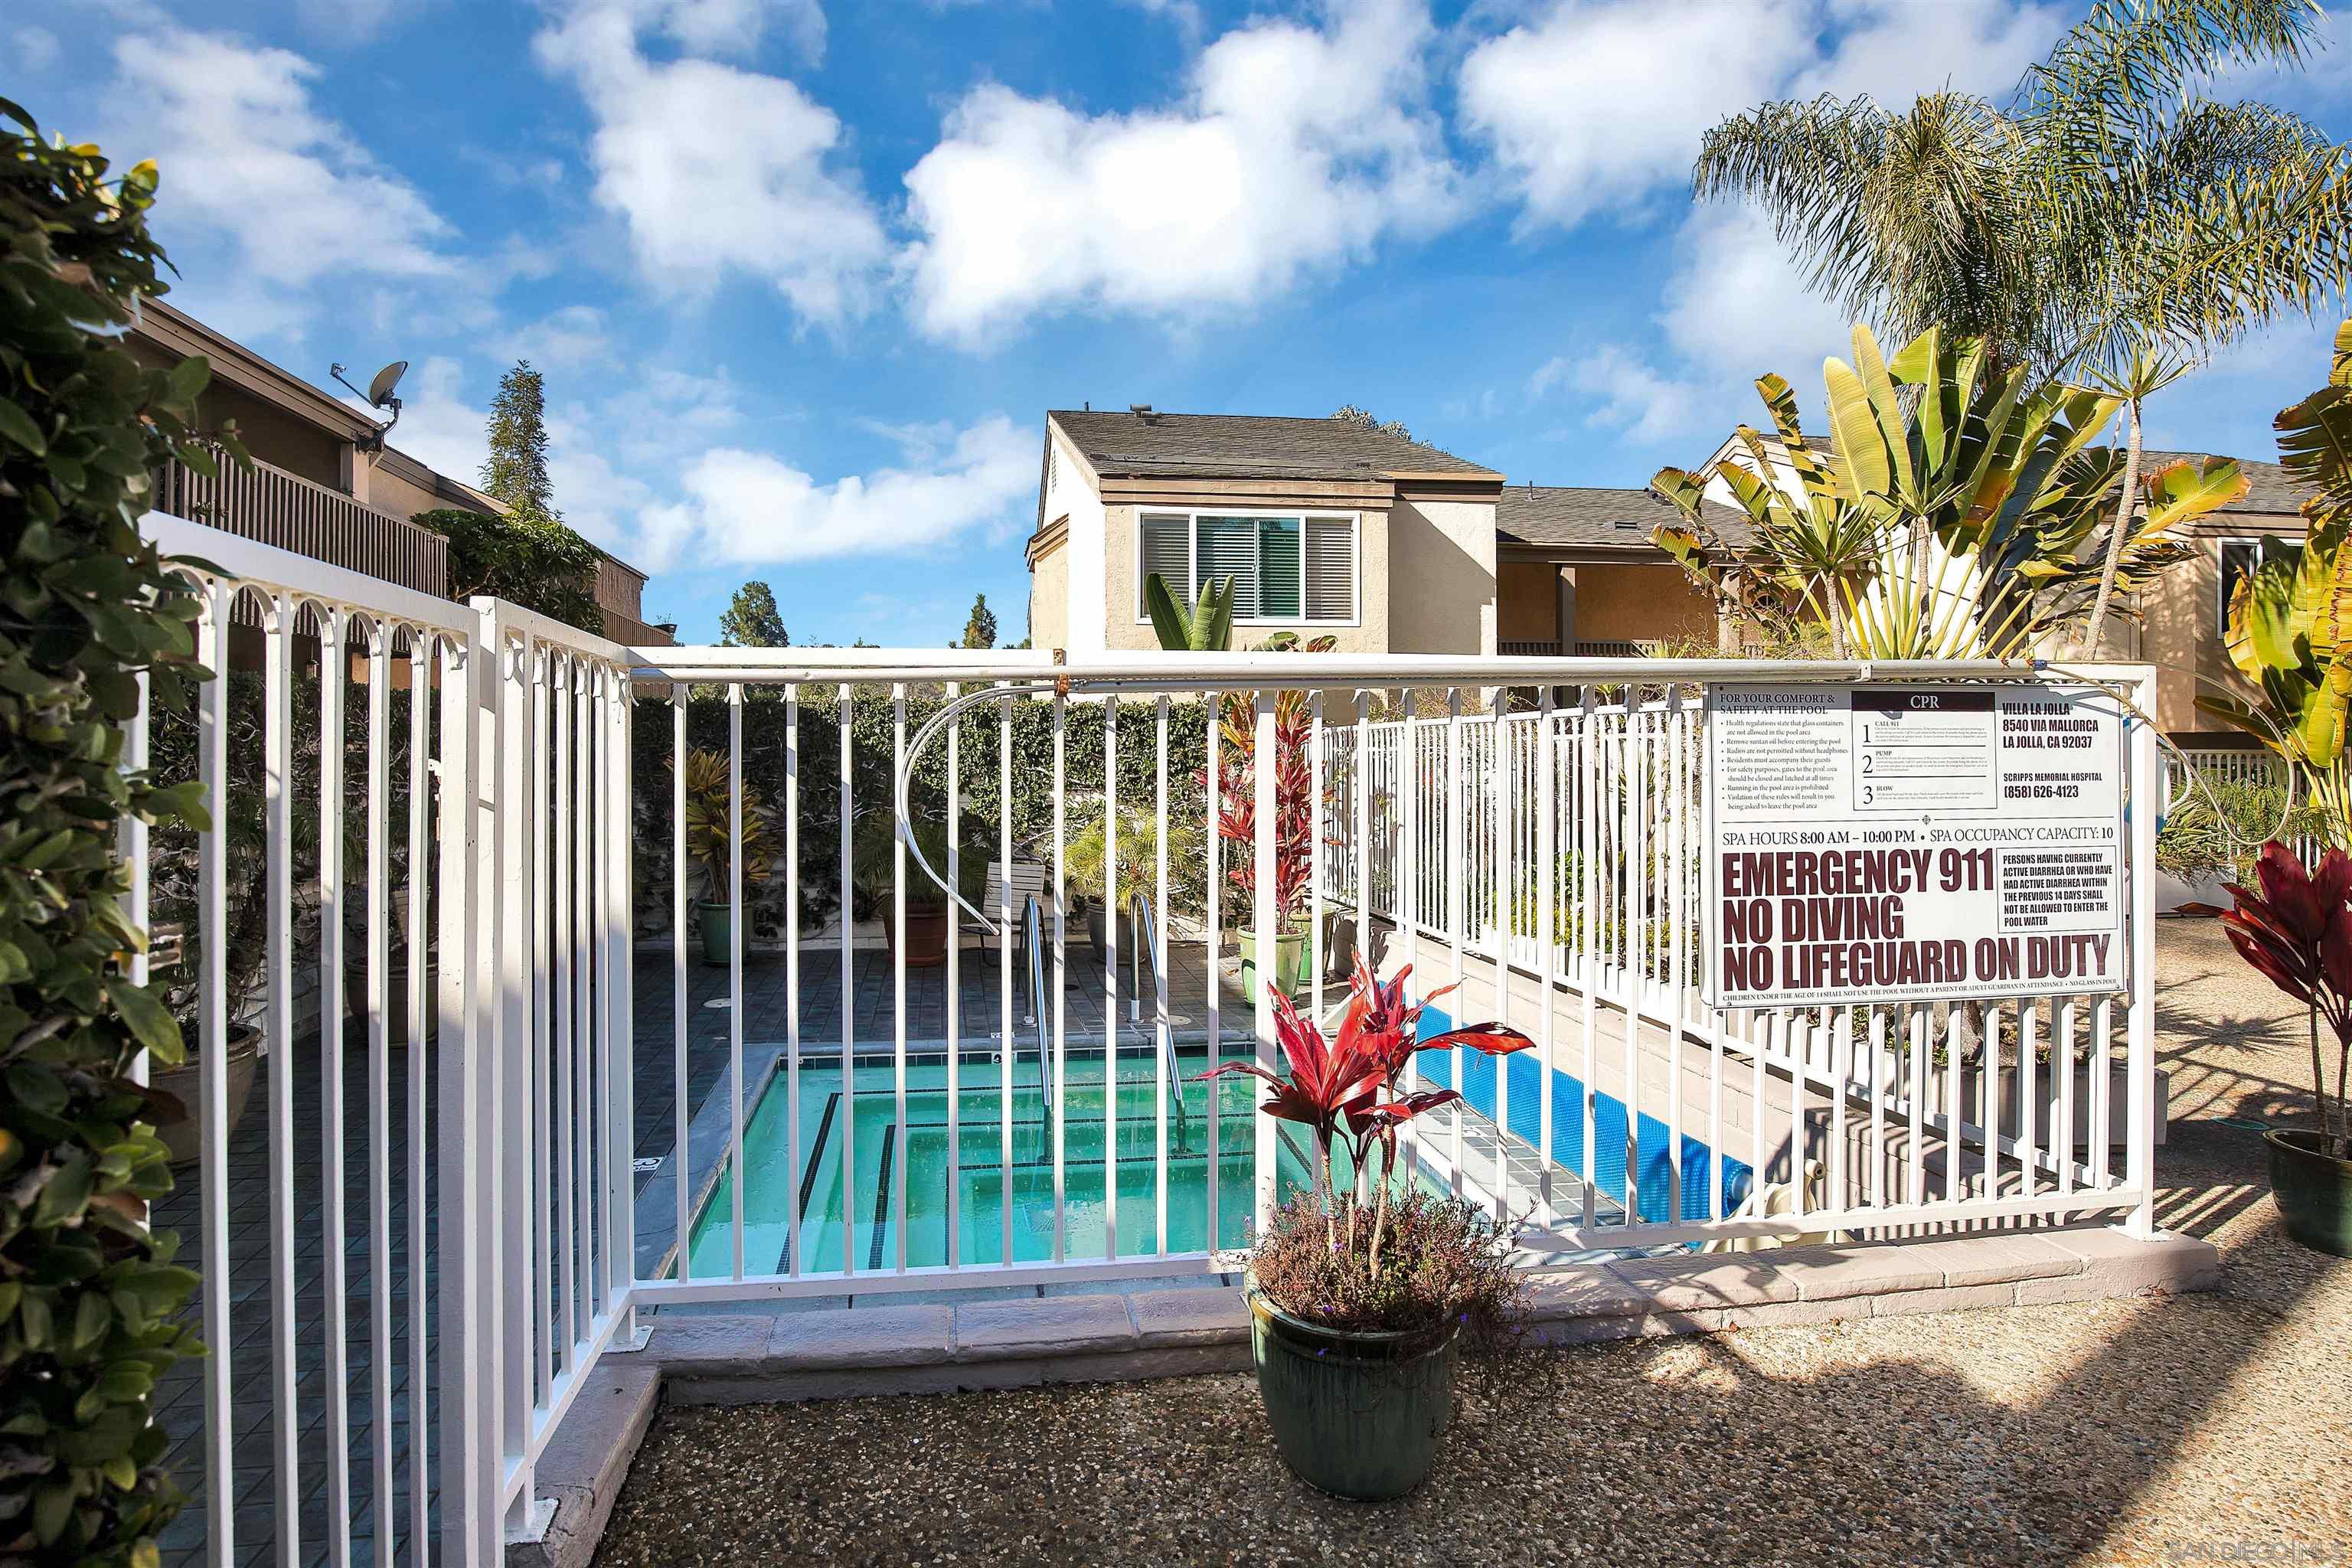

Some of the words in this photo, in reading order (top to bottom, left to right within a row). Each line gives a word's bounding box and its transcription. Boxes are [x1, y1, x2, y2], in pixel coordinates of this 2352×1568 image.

[1721, 694, 1740, 703] FOR
[1744, 694, 1772, 703] YOUR
[1775, 694, 1824, 703] COMFORT
[1828, 694, 1834, 703] &
[1910, 695, 1939, 708] CPR
[1720, 706, 1759, 714] SAFETY
[1762, 705, 1776, 714] AT
[1778, 705, 1798, 714] THE
[1801, 705, 1828, 714] POOL
[2002, 703, 2028, 715] VILLA
[2030, 703, 2041, 715] LA
[2043, 703, 2069, 715] JOLLA
[2003, 719, 2028, 731] 8540
[2030, 720, 2047, 731] VIA
[2049, 720, 2099, 731] MALLORCA
[1864, 725, 1870, 743] 1
[2003, 736, 2014, 748] LA
[2016, 736, 2045, 749] JOLLA,
[2047, 736, 2060, 748] CA
[2062, 736, 2092, 748] 92037
[1738, 766, 1753, 774] safety
[1863, 755, 1873, 773] 2
[2004, 773, 2033, 782] SCRIPPS
[2071, 773, 2102, 781] HOSPITAL
[1864, 786, 1873, 804] 3
[2004, 786, 2031, 798] (858)
[2034, 786, 2078, 798] 626-4123
[1728, 803, 1743, 812] being
[1793, 802, 1805, 811] pool
[1723, 833, 1746, 845] SPA
[1749, 832, 1798, 844] HOURS
[1800, 832, 1824, 844] 8:00
[1827, 831, 1850, 843] AM
[1864, 831, 1892, 842] 10:00
[1895, 831, 1915, 842] PM
[1930, 830, 1952, 841] SPA
[1955, 828, 2034, 841] OCCUPANCY
[2037, 828, 2099, 839] CAPACITY:
[2102, 827, 2113, 838] 10
[2003, 854, 2035, 864] PERSONS
[2037, 854, 2063, 864] HAVING
[2065, 854, 2102, 863] CURRENTLY
[1723, 851, 1932, 897] EMERGENCY
[1939, 848, 1994, 892] 911
[2004, 867, 2028, 877] ACTIVE
[2030, 867, 2064, 876] DIARRHEA
[2066, 866, 2075, 875] OR
[2076, 865, 2093, 874] WHO
[2096, 865, 2112, 874] HAVE
[2004, 880, 2018, 890] HAD
[2020, 880, 2044, 889] ACTIVE
[2046, 878, 2080, 888] DIARRHEA
[2082, 877, 2107, 887] WITHIN
[2004, 893, 2017, 902] THE
[2019, 891, 2053, 901] PREVIOUS
[2055, 891, 2063, 900] 14
[2064, 890, 2081, 900] DAYS
[2082, 890, 2103, 899] SHALL
[2004, 905, 2018, 914] NOT
[2020, 905, 2028, 913] BE
[2030, 903, 2062, 913] ALLOWED
[2063, 903, 2072, 912] TO
[2074, 903, 2094, 912] ENTER
[2096, 902, 2108, 911] THE
[1723, 899, 1772, 944] NO
[1782, 895, 1904, 942] DIVING
[2004, 917, 2023, 926] POOL
[2024, 916, 2047, 926] WATER
[1723, 946, 1773, 991] NO
[1782, 940, 1967, 989] LIFEGUARD
[1975, 937, 2020, 982] ON
[2027, 934, 2111, 978] DUTY
